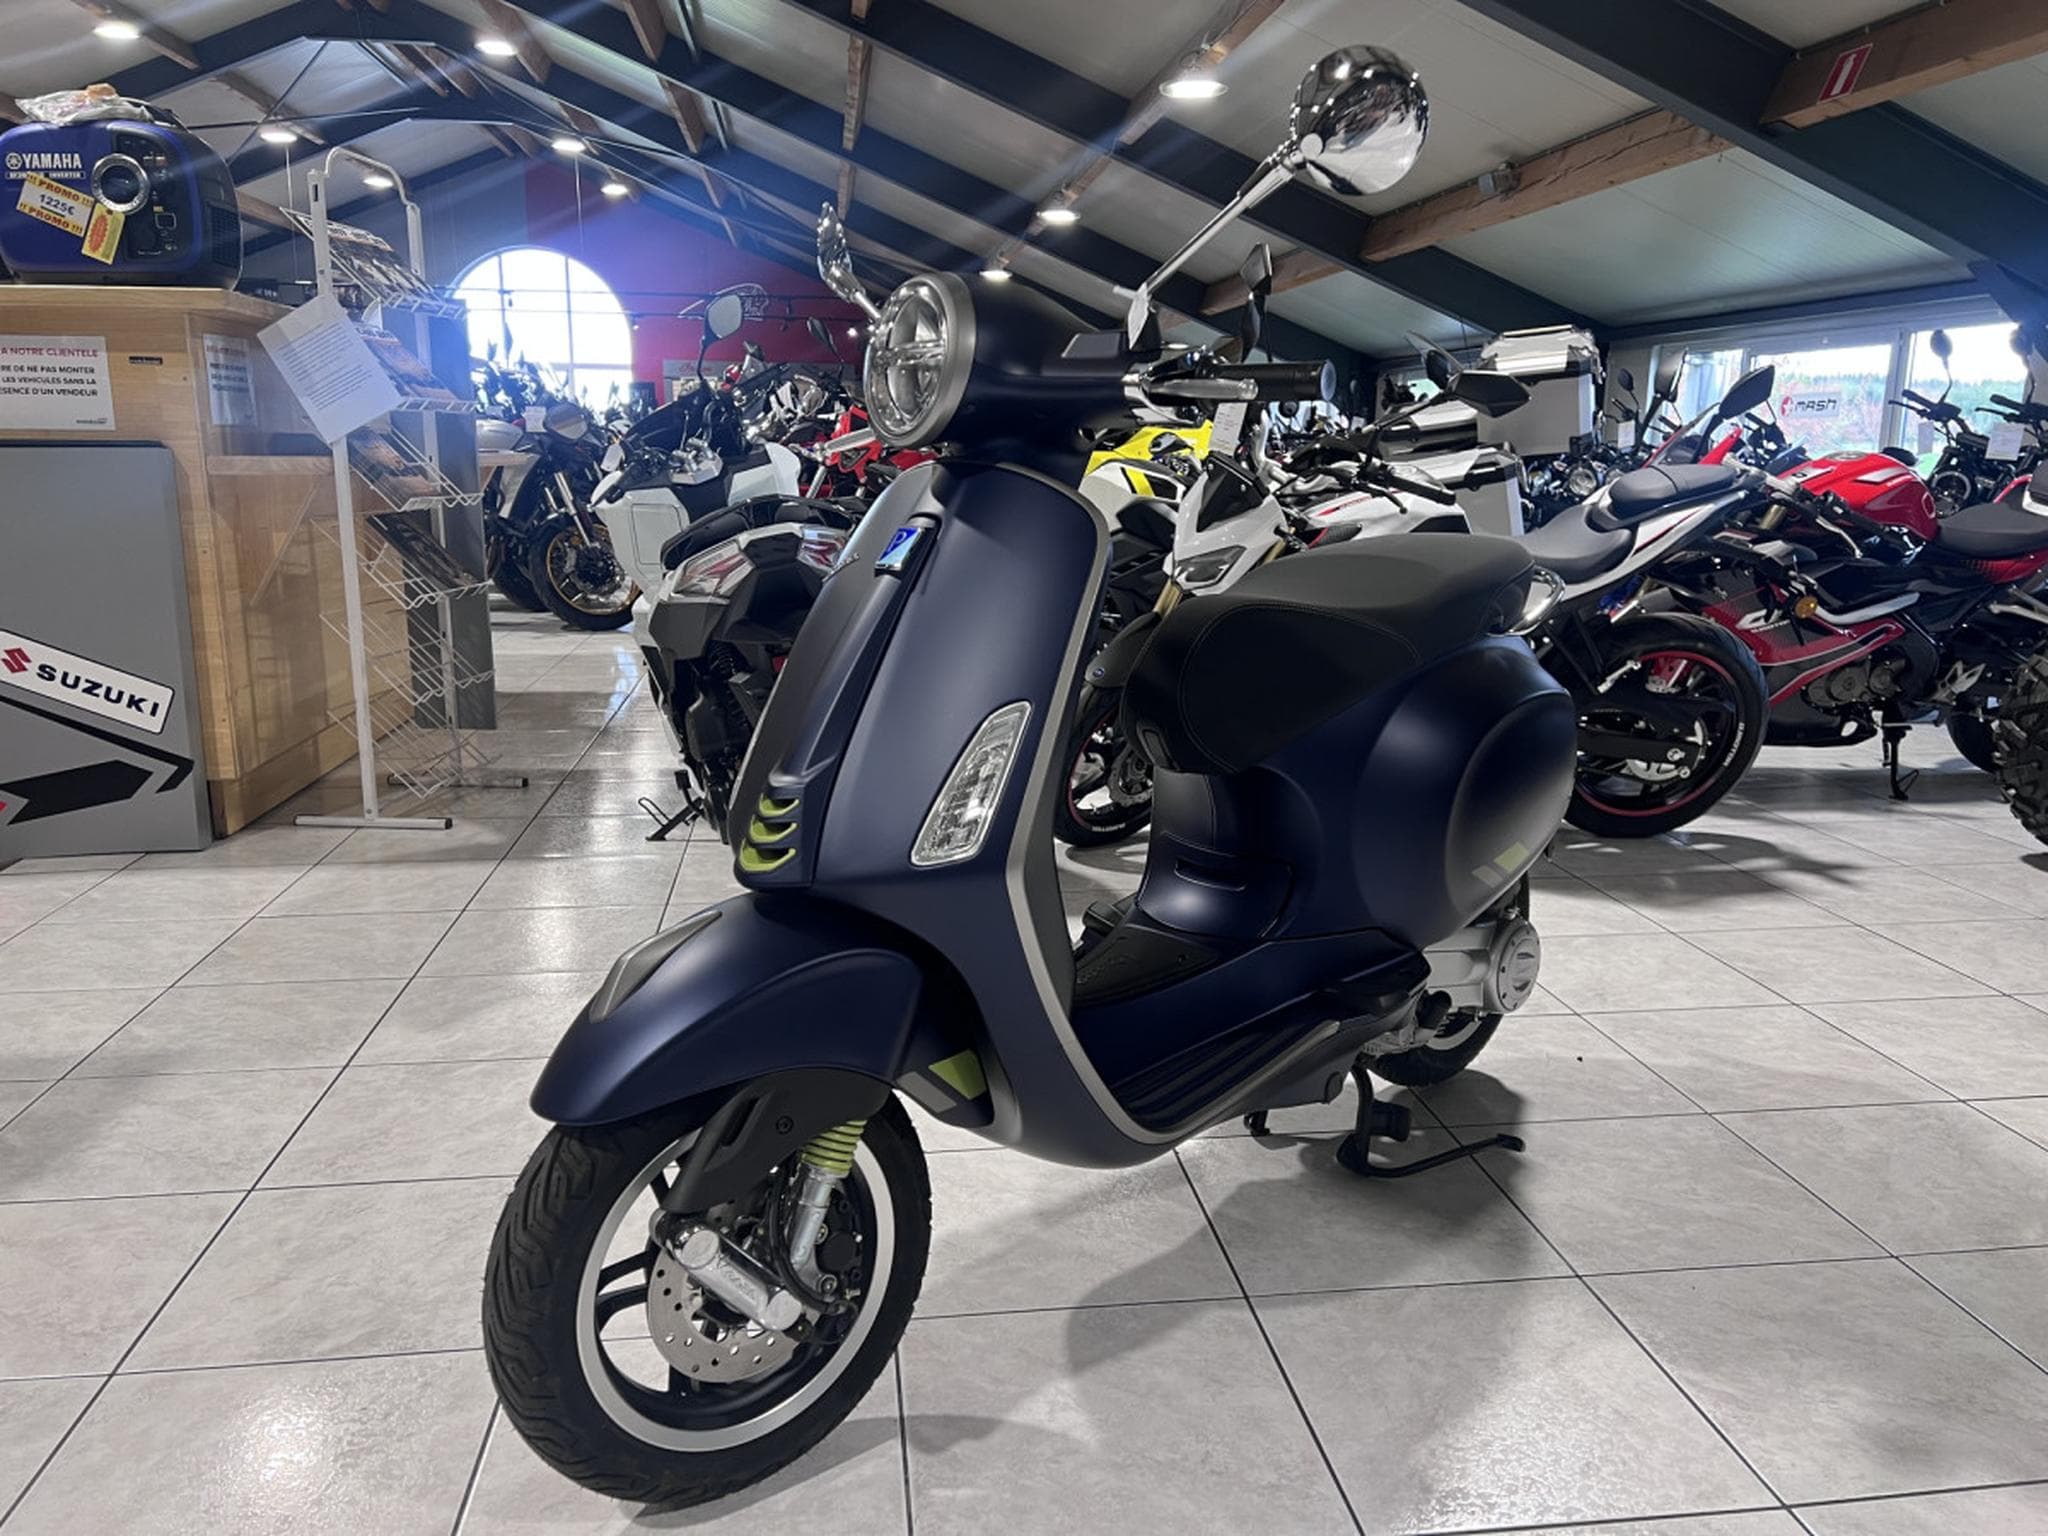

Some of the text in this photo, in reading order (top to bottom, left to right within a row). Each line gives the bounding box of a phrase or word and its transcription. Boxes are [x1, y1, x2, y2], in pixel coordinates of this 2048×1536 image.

[22, 153, 82, 169] YAMAHA
[39, 179, 80, 201] PROMO
[40, 194, 76, 216] 1225€
[28, 207, 70, 229] PROMO
[10, 347, 44, 356] NOTRE
[46, 348, 98, 358] CLIENTELE
[27, 365, 38, 373] NE
[59, 366, 95, 374] MONTER
[18, 377, 61, 385] VEHICULES
[36, 664, 159, 717] SUZUKI
